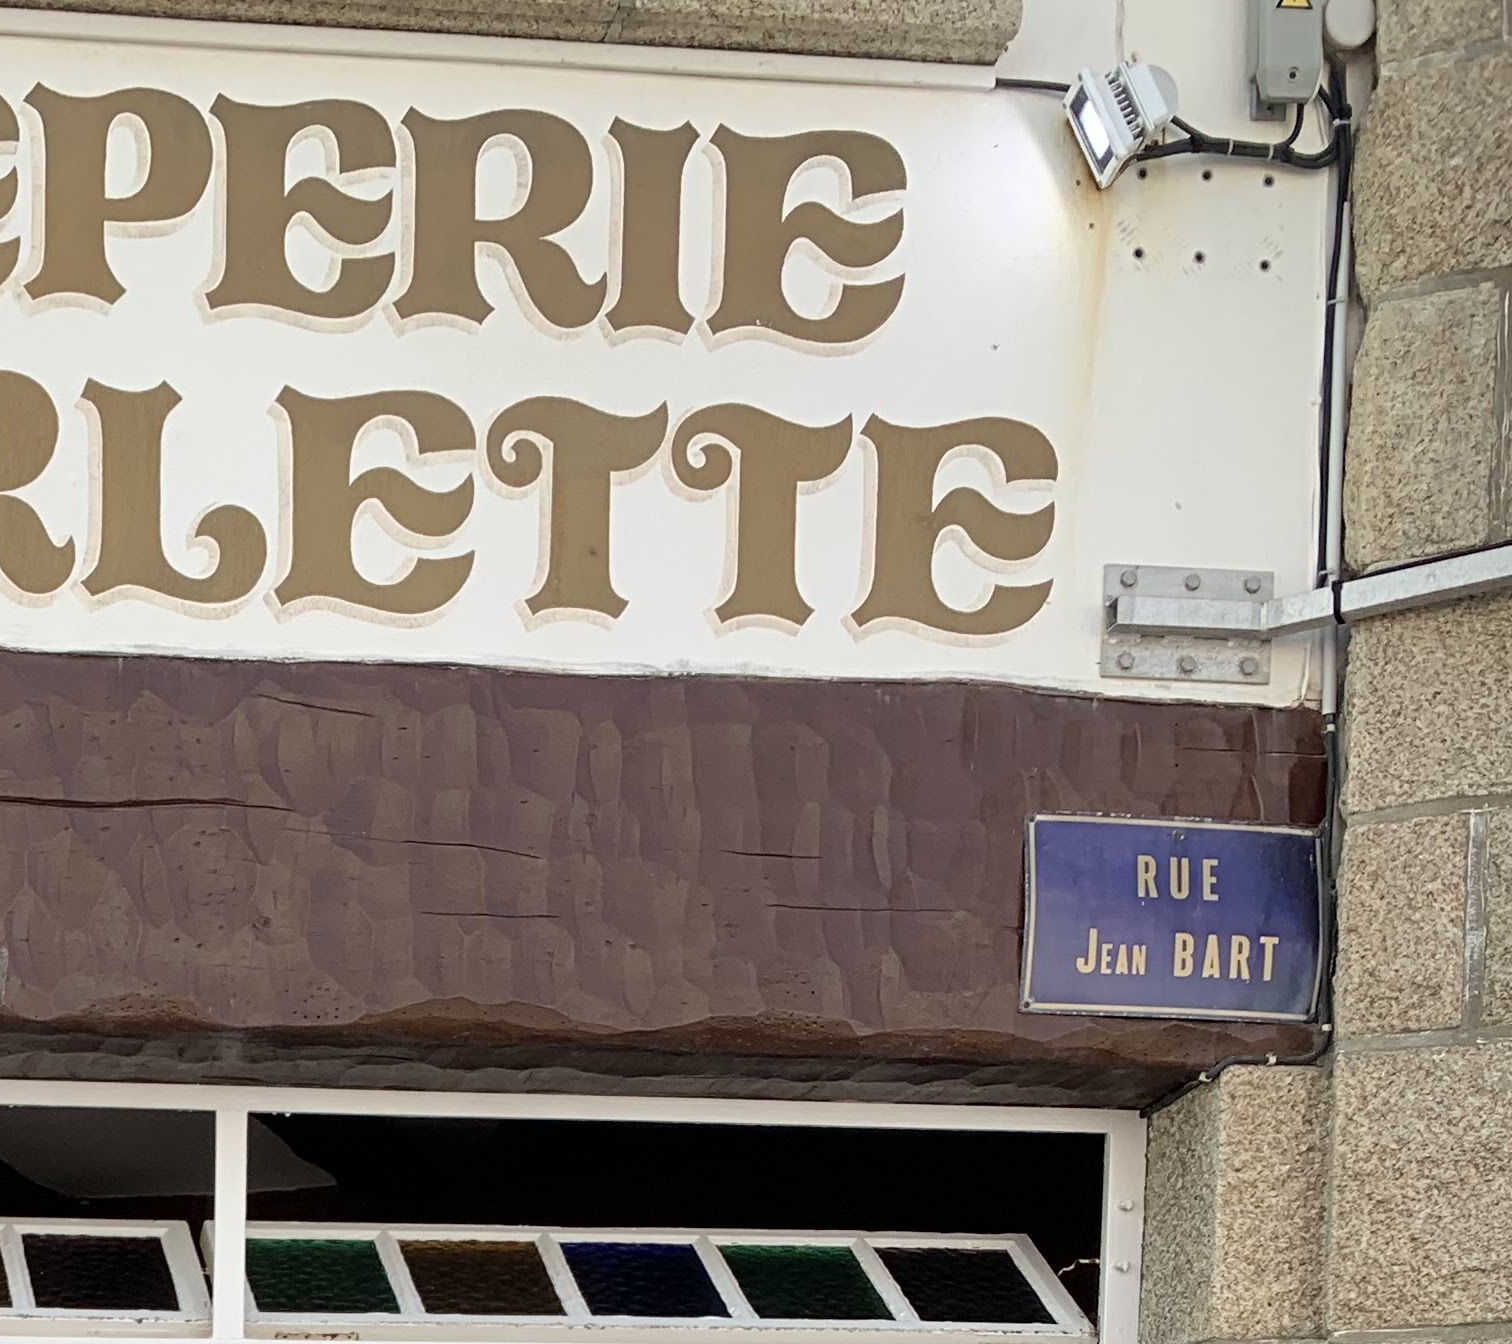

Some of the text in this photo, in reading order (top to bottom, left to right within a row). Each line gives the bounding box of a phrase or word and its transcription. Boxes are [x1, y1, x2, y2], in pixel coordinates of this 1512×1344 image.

[1137, 855, 1220, 902] RUE
[1076, 927, 1280, 982] JEAN BART
